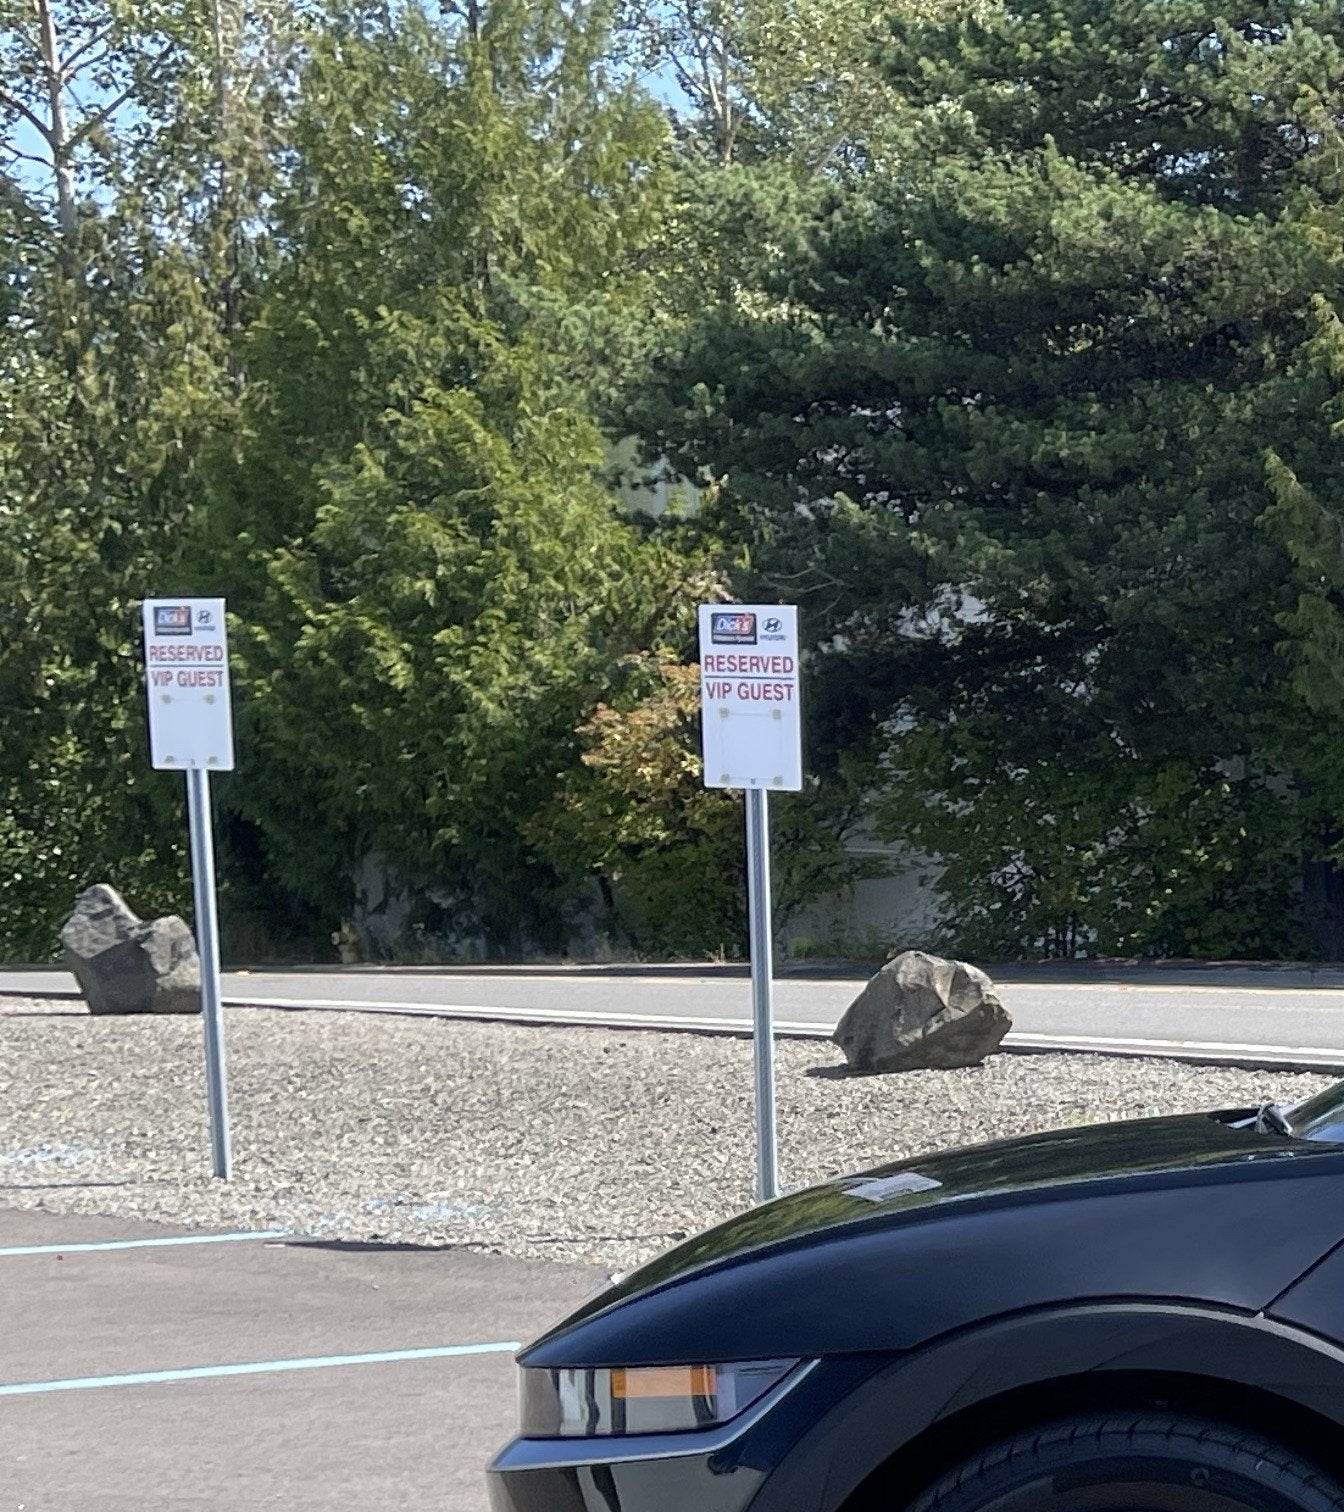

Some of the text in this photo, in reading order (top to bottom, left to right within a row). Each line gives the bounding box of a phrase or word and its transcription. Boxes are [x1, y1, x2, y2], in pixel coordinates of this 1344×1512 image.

[149, 644, 223, 662] RESERVED
[704, 654, 794, 674] RESERVED
[150, 670, 224, 688] VIP GUEST
[706, 681, 794, 701] VIP GUEST
